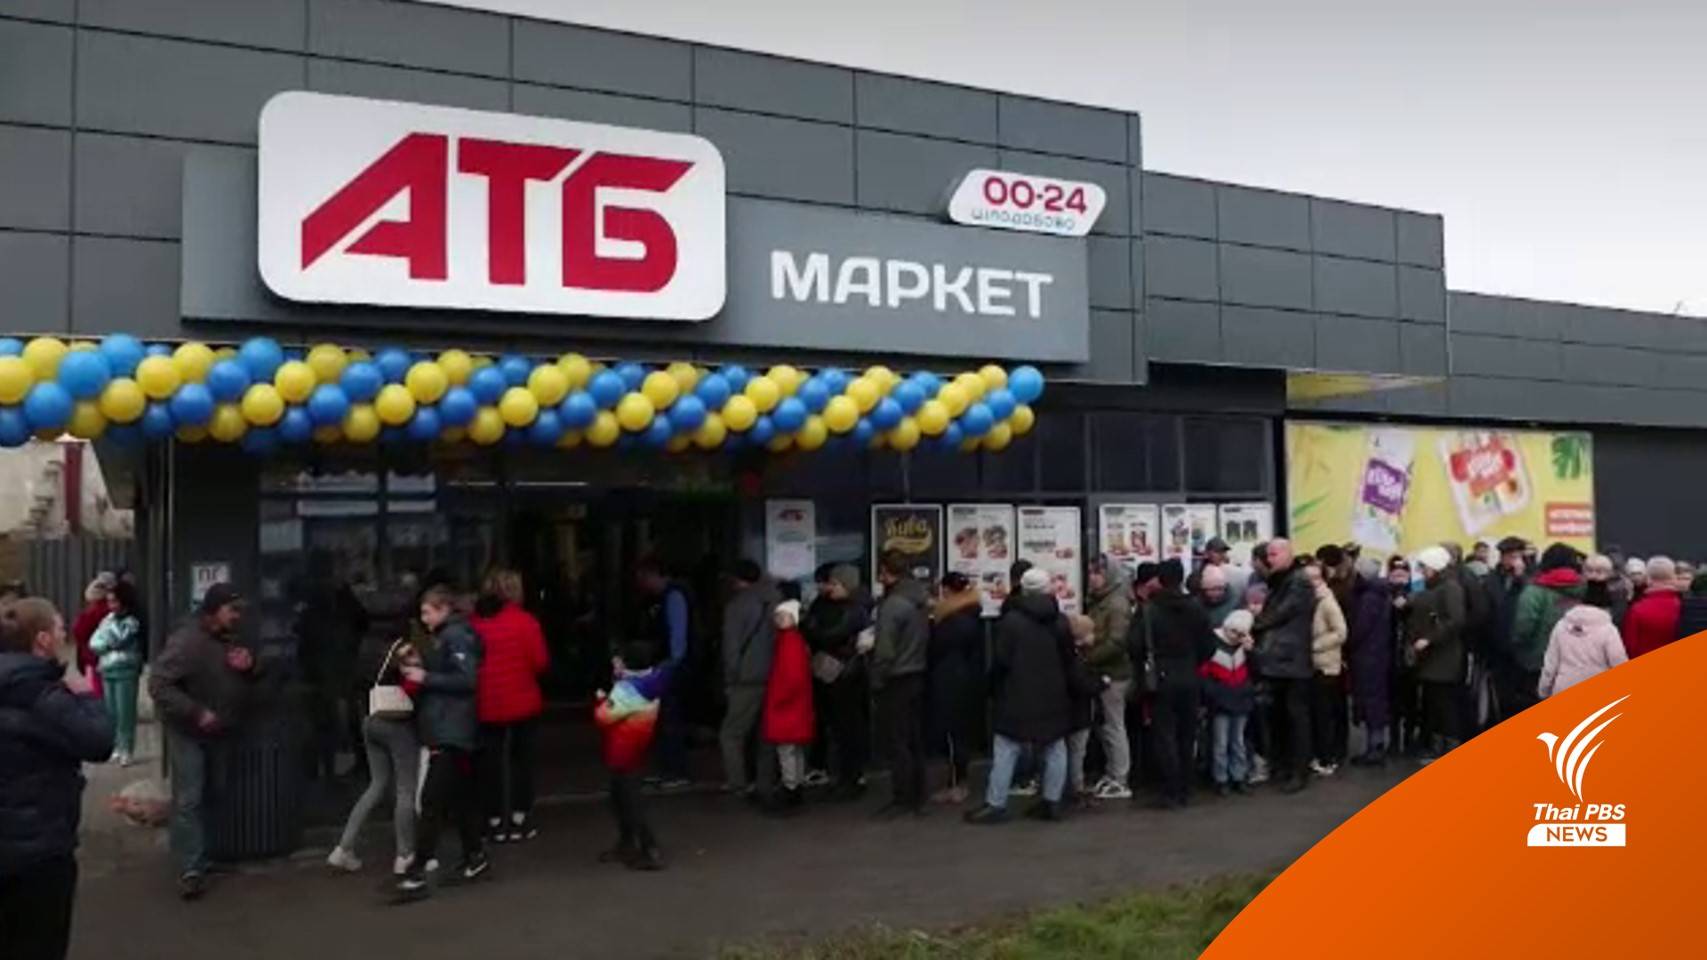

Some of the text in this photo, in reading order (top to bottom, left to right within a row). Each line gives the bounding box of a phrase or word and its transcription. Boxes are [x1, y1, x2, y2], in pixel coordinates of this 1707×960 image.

[301, 131, 696, 293] АТБ
[983, 176, 1087, 214] 00-24
[770, 249, 1053, 319] МАРКЕТ
